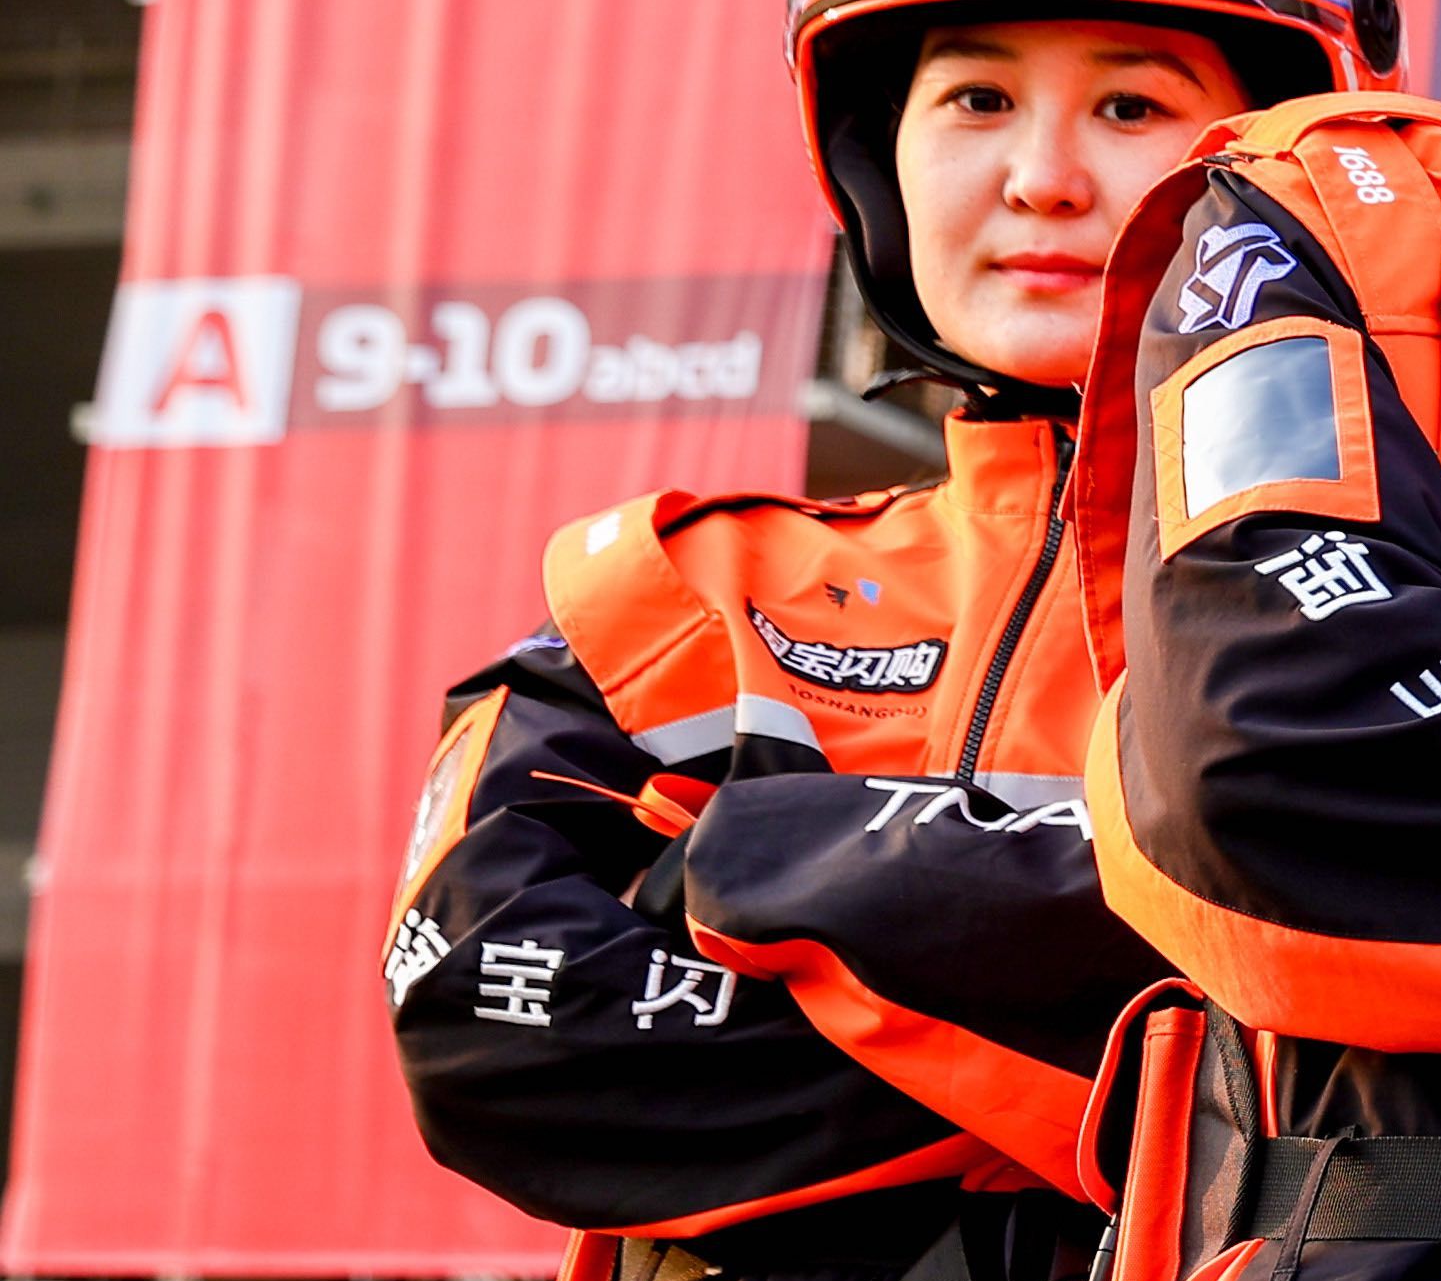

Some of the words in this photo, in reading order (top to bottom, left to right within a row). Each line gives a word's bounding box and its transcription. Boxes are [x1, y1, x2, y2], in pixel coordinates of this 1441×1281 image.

[1333, 144, 1396, 206] 1688
[150, 309, 252, 415] A
[751, 609, 942, 689] 淘宝闪购
